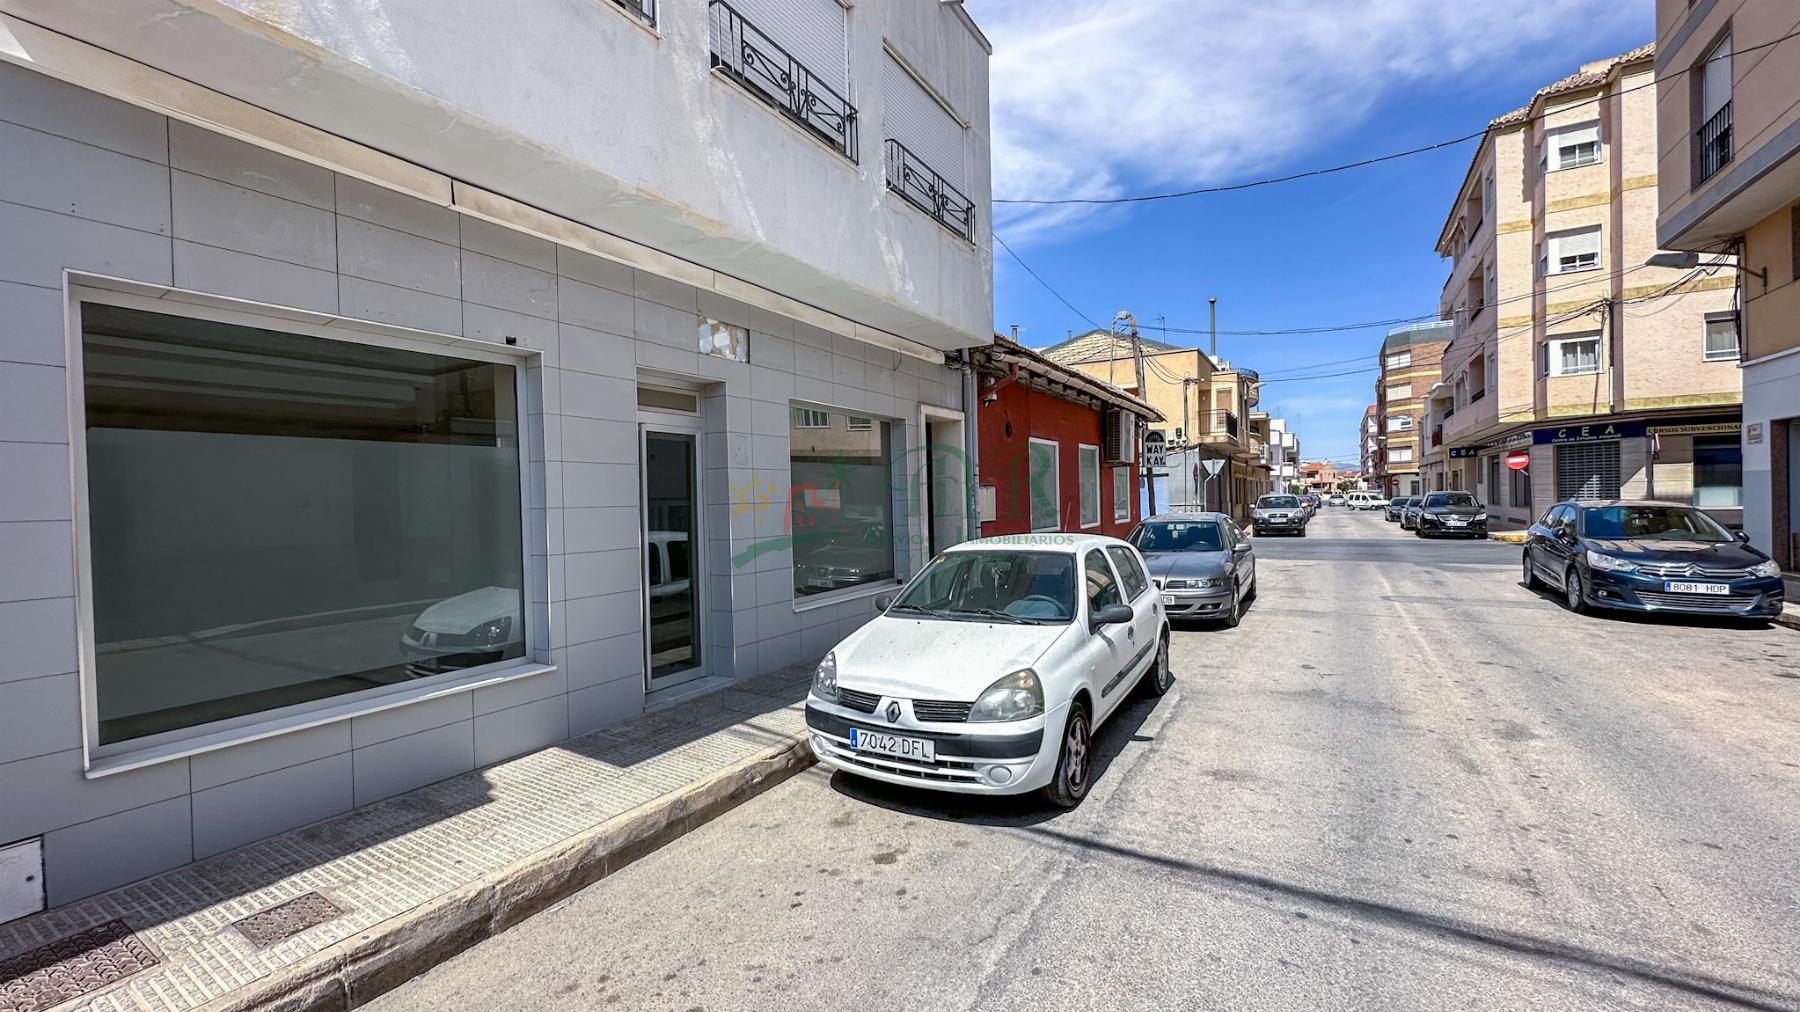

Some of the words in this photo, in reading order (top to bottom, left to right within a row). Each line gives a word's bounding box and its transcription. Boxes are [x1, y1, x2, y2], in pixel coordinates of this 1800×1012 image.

[1647, 426, 1679, 434] CURSOS
[1146, 444, 1164, 454] WAY
[1673, 583, 1698, 592] 8081
[860, 732, 897, 753] 7042
[902, 739, 931, 759] DFL
